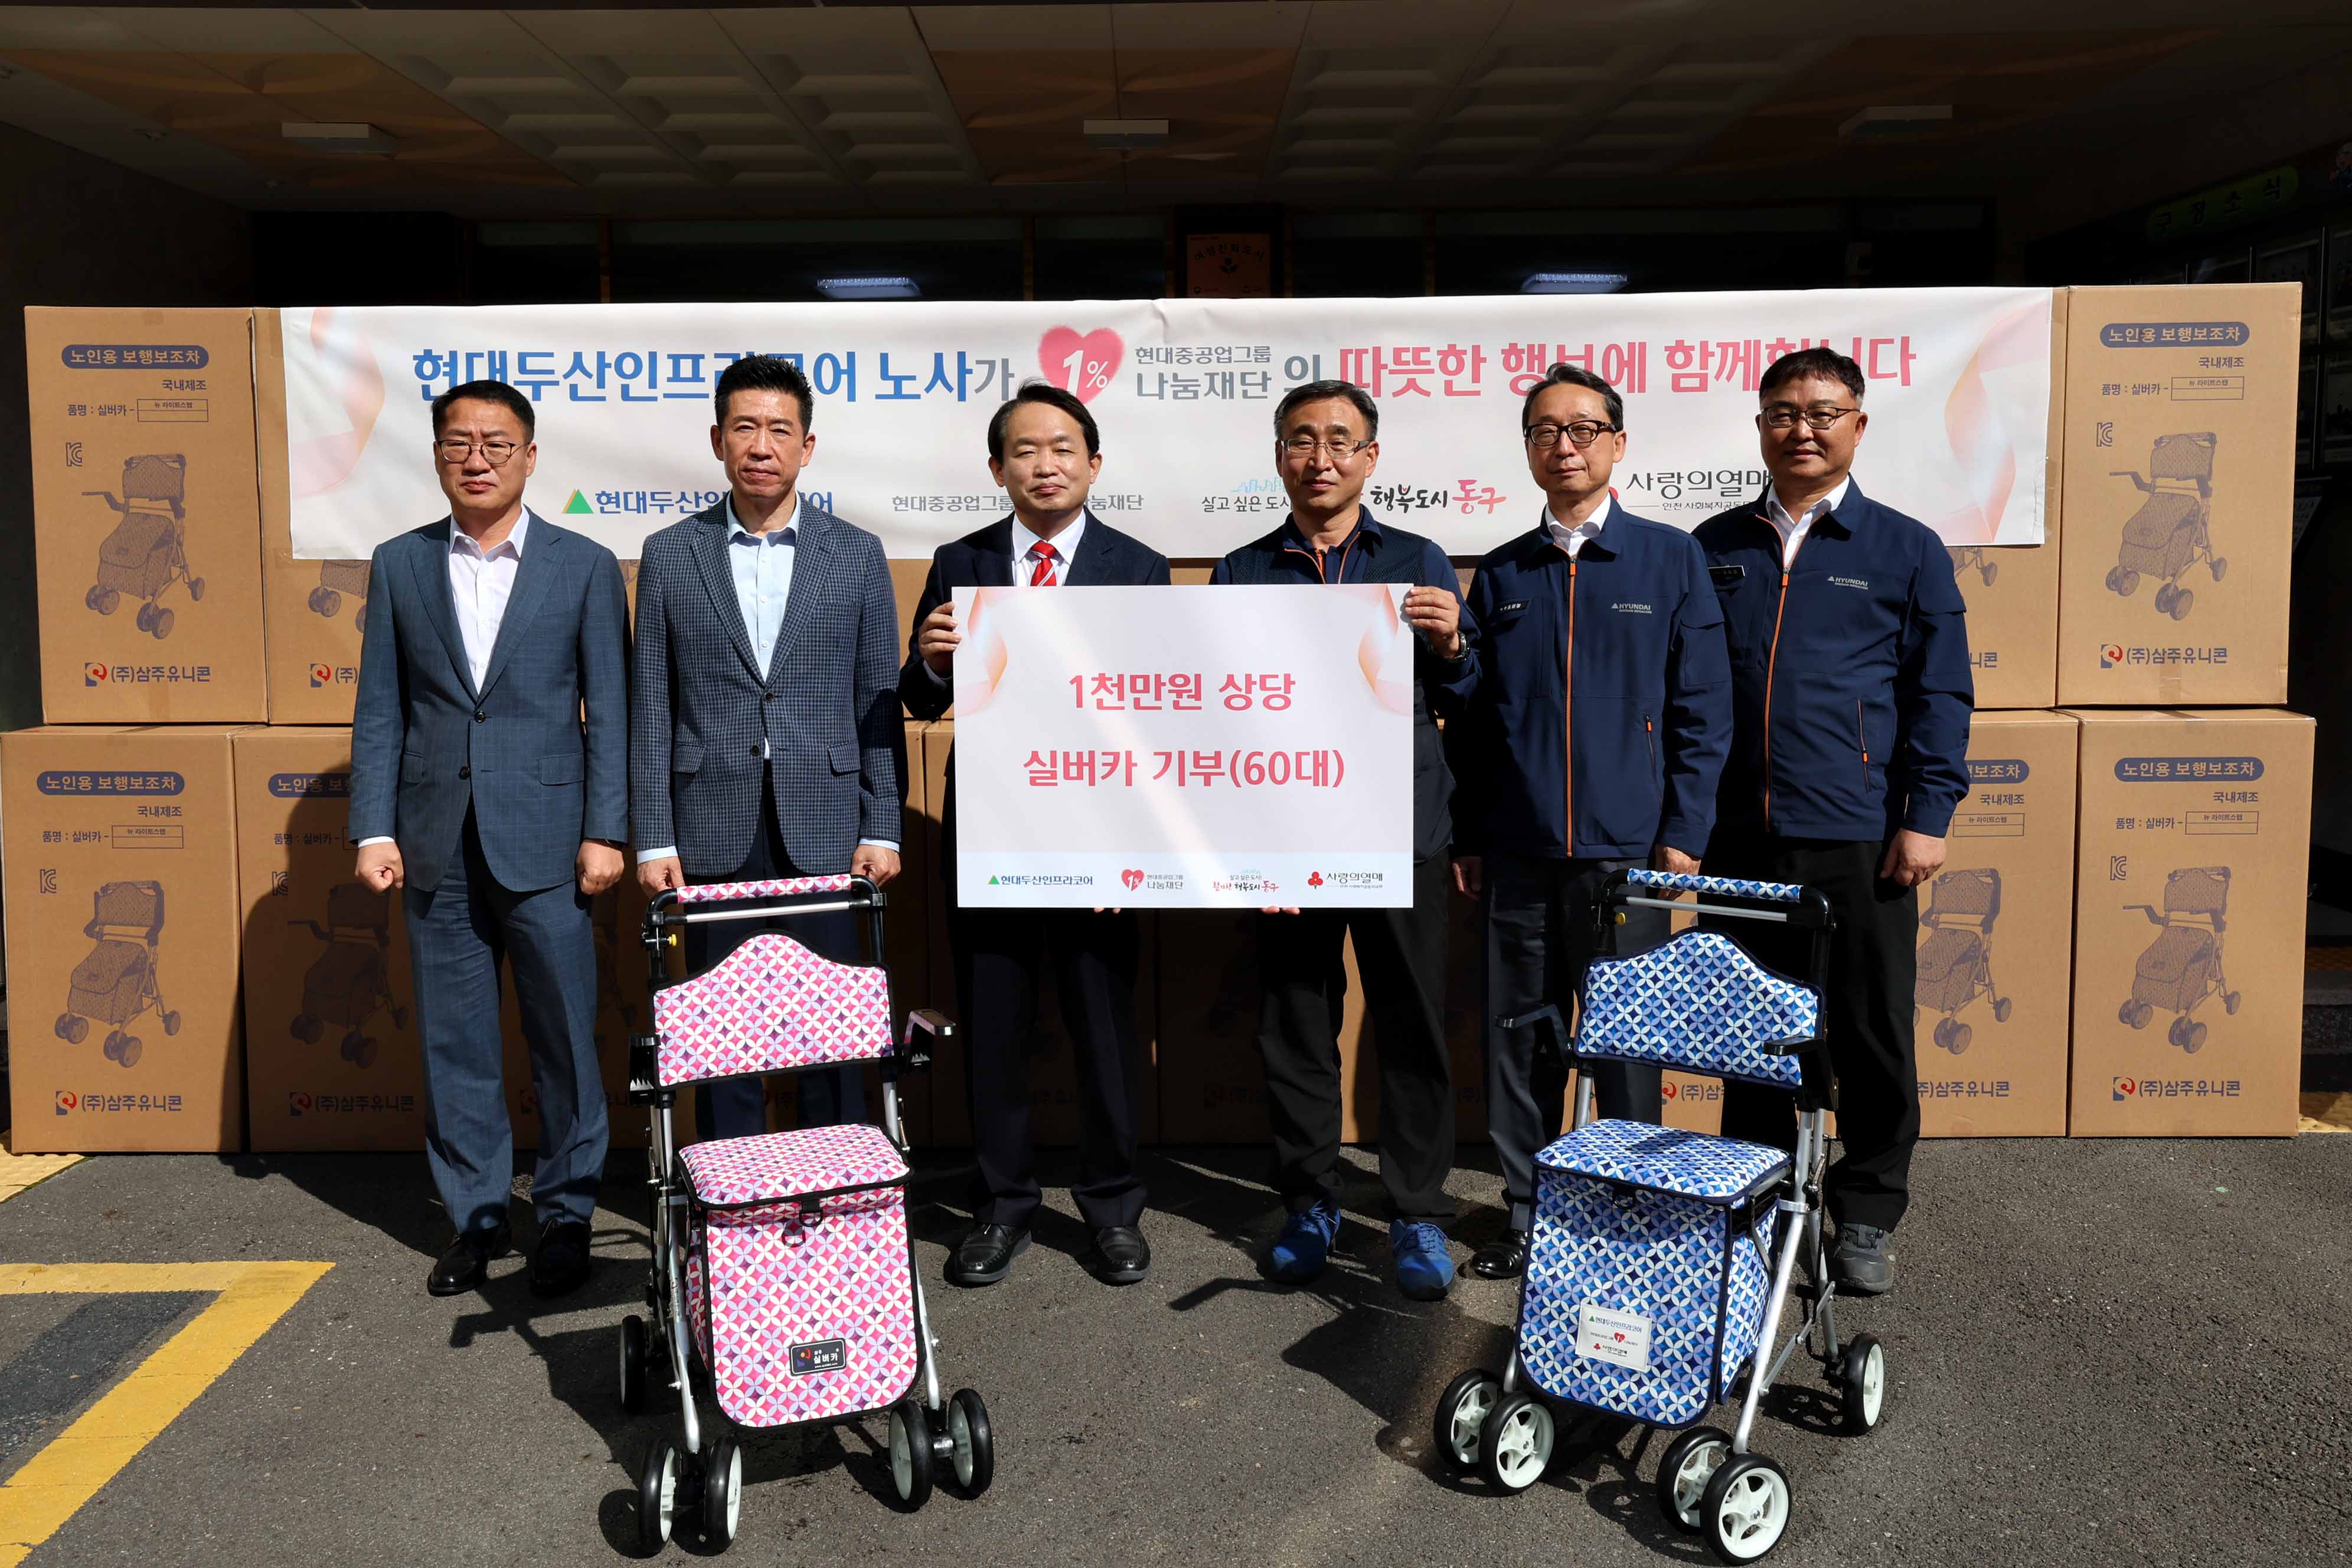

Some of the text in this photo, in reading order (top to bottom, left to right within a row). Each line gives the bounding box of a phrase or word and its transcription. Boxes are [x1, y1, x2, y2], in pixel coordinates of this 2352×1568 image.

[2108, 326, 2241, 342] 노인용 보행보조차
[70, 349, 201, 365] 노인용 보행보조차
[1135, 345, 1272, 365] 현대중공업그룹
[2199, 356, 2245, 368] 국내제조
[413, 348, 1015, 403] 현대두산인프어 노사가
[1340, 343, 1488, 398] 따뜻한
[162, 379, 207, 391] 국내제조
[1136, 371, 1272, 401] 나눔재단
[2101, 383, 2121, 396] 품명
[2131, 383, 2161, 396] 실버카
[67, 404, 87, 416] 품명
[97, 404, 127, 416] 실버카
[1626, 470, 1770, 499] 사랑의열매
[892, 494, 1144, 512] 현대중공업그룹 눔재단
[1201, 495, 1230, 512] 살고
[1233, 495, 1262, 512] 싶은
[1370, 478, 1507, 514] 행복도시 동구
[1662, 502, 1682, 511] 인천
[1835, 576, 1868, 586] HYUNDAI
[2126, 647, 2228, 666] (주)삼주유니콘
[110, 664, 211, 684] (주)삼주유니콘
[1069, 672, 1296, 711] 1천만원 상당
[1023, 749, 1345, 788] 실버카 기부(60대)
[2123, 762, 2255, 777] 노인용 보행보조차
[45, 775, 177, 790] 노인용 보행보조차
[277, 778, 322, 793] 노인용
[1979, 794, 2025, 806] 국내제조
[2213, 791, 2259, 803] 국내제조
[137, 805, 182, 818] 국내제조
[2115, 817, 2135, 830] 품명
[2145, 816, 2175, 829] 실버카
[43, 830, 62, 843] 품명
[72, 830, 102, 843] 실버카
[274, 832, 331, 845] 품명 실버카
[1001, 875, 1093, 886] 현대두산인프라코어
[1147, 881, 1183, 890] 나눔재단
[1262, 880, 1279, 892] 동구
[1327, 873, 1383, 884] 사랑의열매
[2138, 1080, 2240, 1098] (주)삼주유니콘
[81, 1094, 182, 1113] (주)삼주유니콘
[814, 1353, 838, 1364] 실버카
